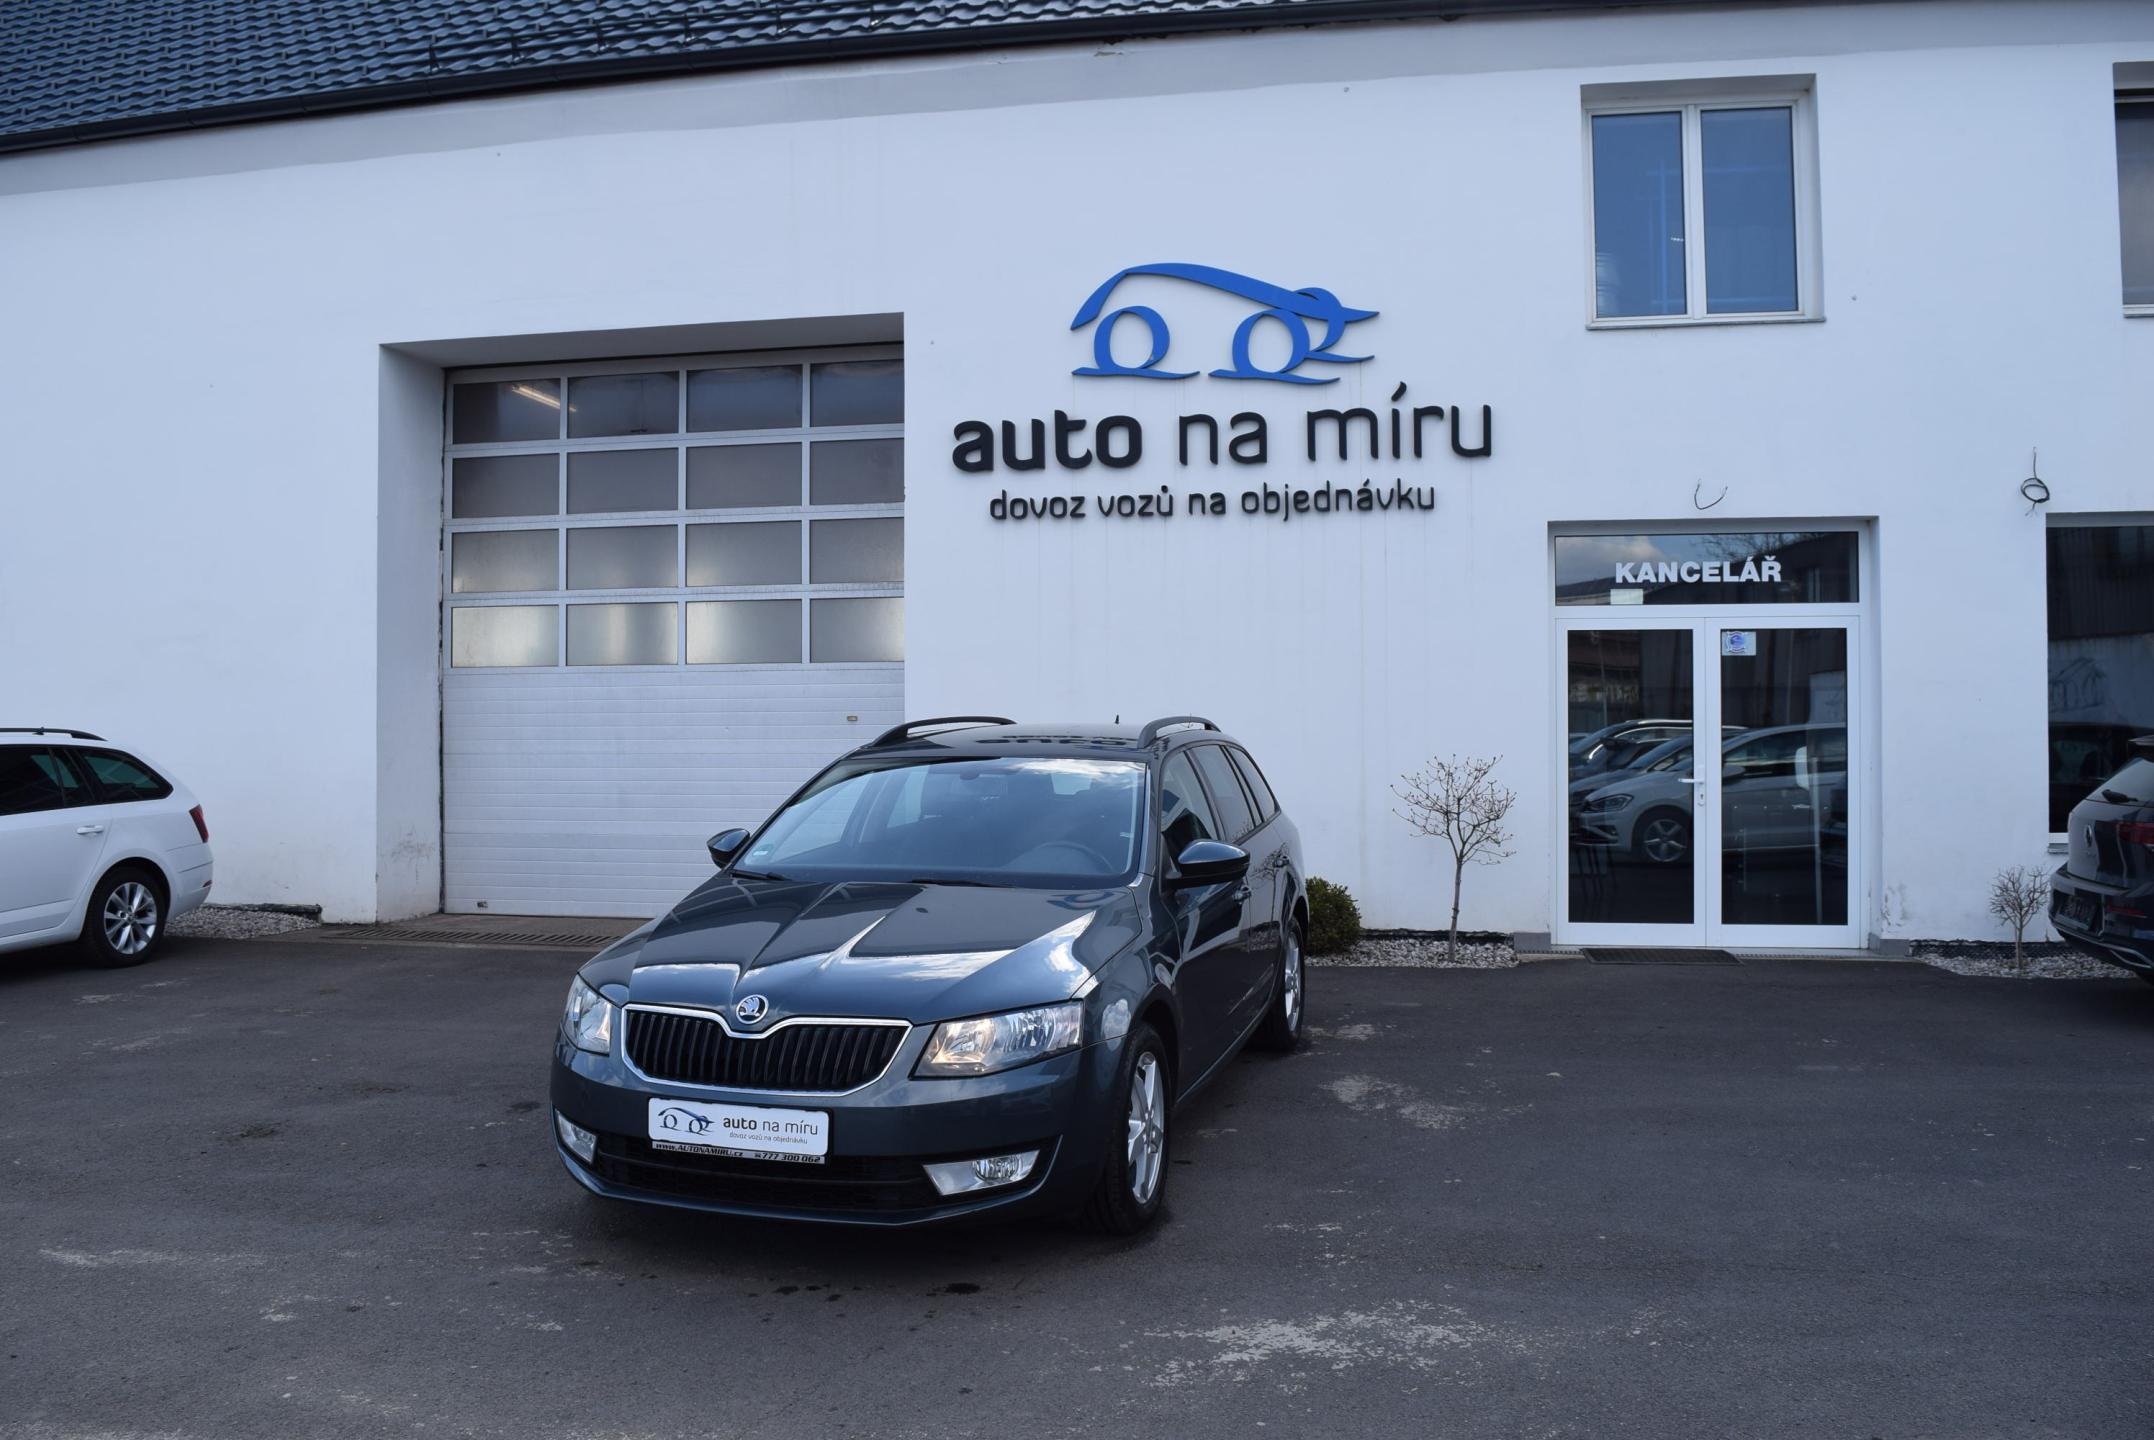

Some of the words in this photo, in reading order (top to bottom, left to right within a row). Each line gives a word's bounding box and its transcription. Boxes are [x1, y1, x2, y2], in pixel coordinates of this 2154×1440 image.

[952, 409, 1143, 473] auto
[1179, 411, 1268, 466] na
[1307, 381, 1492, 461] míru
[989, 490, 1086, 521] dovoz
[1098, 485, 1174, 518] vozů
[1188, 489, 1227, 516] na
[1241, 478, 1435, 522] objednávku
[1615, 555, 1782, 583] KANCELÁŘ
[723, 1117, 757, 1130] auto
[762, 1121, 780, 1132] na
[785, 1119, 818, 1135] míru
[762, 1152, 780, 1160] 777
